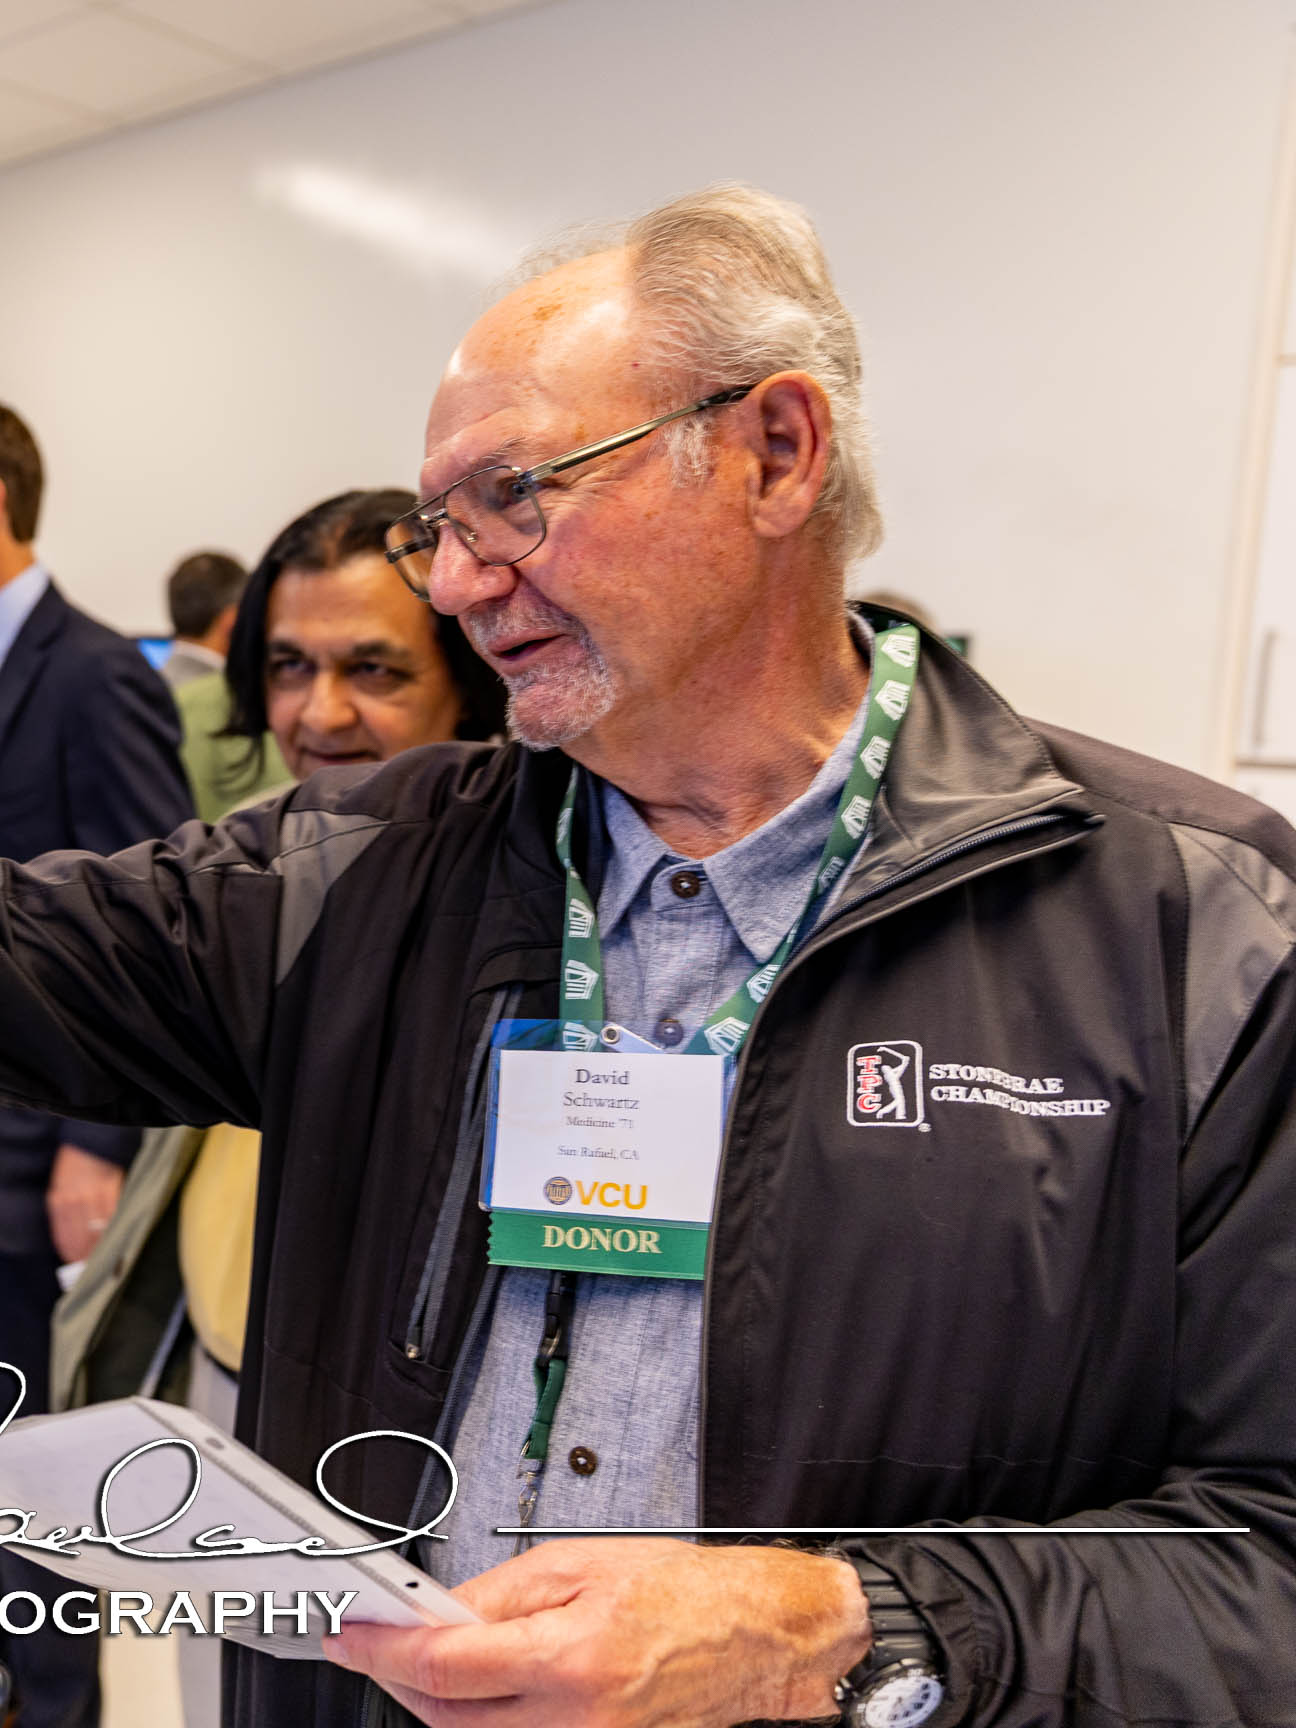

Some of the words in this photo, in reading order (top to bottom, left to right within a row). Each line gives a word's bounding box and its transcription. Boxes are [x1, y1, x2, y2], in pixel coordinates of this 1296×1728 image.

[575, 1068, 630, 1085] David
[856, 1055, 882, 1114] TPC
[928, 1063, 1065, 1095] STONEBRAE
[563, 1091, 640, 1110] Schwartz
[930, 1085, 1111, 1117] CHAMPIONSHIP
[566, 1116, 615, 1128] Medicine
[575, 1180, 649, 1210] VCU
[542, 1225, 663, 1254] DONOR
